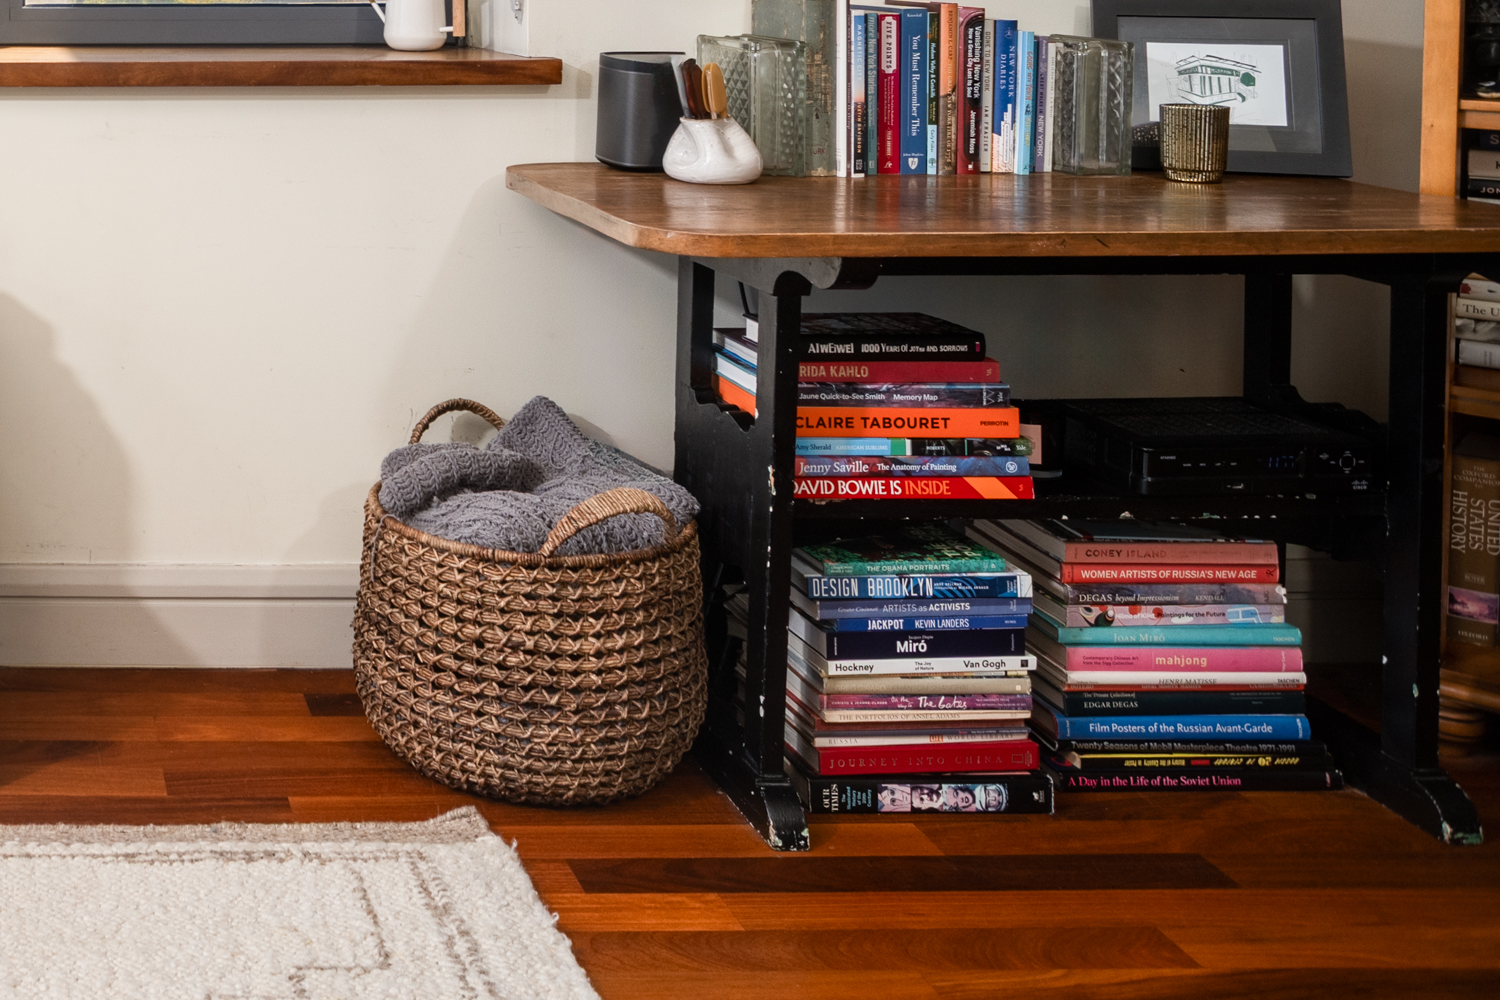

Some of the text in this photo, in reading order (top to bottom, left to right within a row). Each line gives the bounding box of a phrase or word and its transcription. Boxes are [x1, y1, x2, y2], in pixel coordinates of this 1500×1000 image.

[973, 26, 982, 63] Vanishing
[911, 35, 920, 136] You Must Remember This
[973, 82, 981, 98] York
[820, 393, 863, 401] Quick-to-See
[795, 417, 950, 428] CLAIRE TABOURET
[799, 462, 868, 475] Jenny Saville
[891, 464, 920, 472] Anatomy
[930, 464, 957, 472] Painting
[838, 480, 887, 494] BOWIE
[890, 481, 902, 494] IS
[905, 481, 951, 494] INSIDE
[1451, 489, 1467, 554] HISTORY
[1469, 498, 1485, 551] STATES
[1487, 499, 1500, 556] UNITED
[1081, 569, 1257, 578] WOMEN ARTISTS OF RUSSIA'S NEW AGE
[812, 578, 933, 596] DESIGN BROOKLYN
[929, 603, 970, 611] ACTIVISTS
[868, 619, 969, 629] JACKPOT KEVIN LANDERS
[896, 640, 927, 653] Miró
[963, 660, 1006, 669] Van Gogh
[1156, 655, 1207, 667] mahjong
[835, 663, 874, 673] Hockney
[1089, 723, 1273, 733] Film Posters of the Russian Avant-Garde
[829, 756, 1002, 769] JOURNEY INTO CHINA
[1068, 776, 1241, 788] A Day in the Life of the Soviet Union
